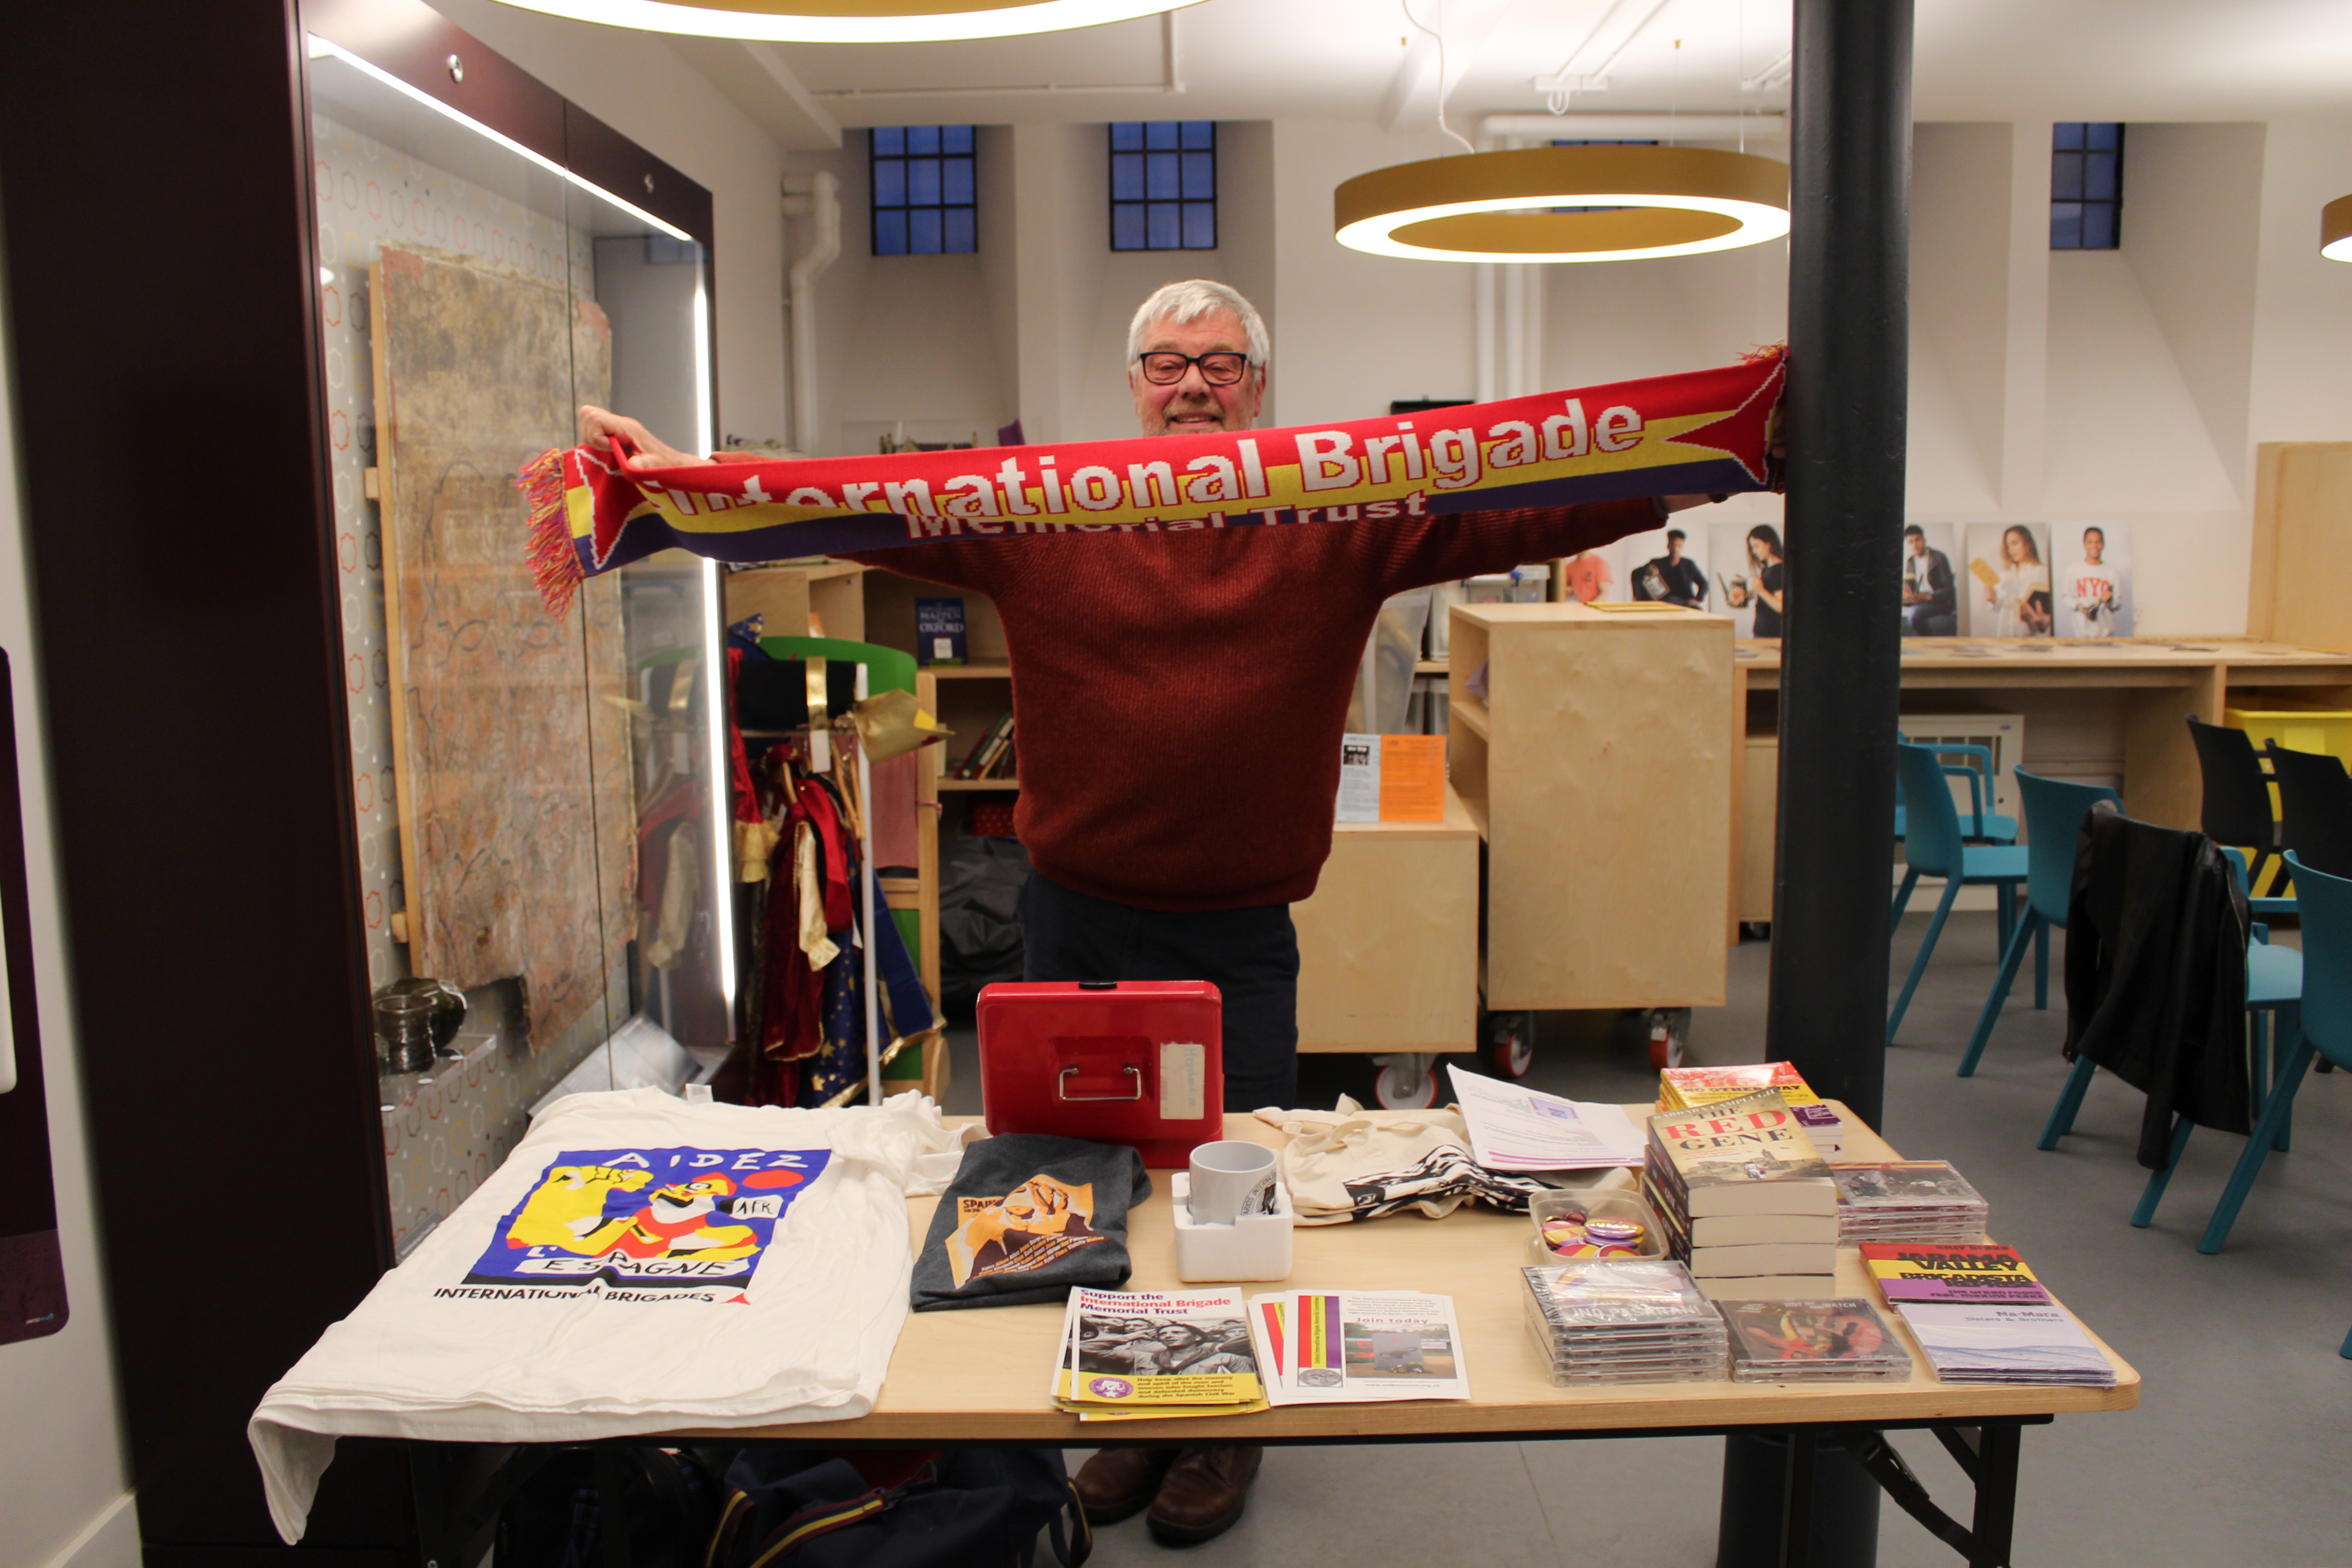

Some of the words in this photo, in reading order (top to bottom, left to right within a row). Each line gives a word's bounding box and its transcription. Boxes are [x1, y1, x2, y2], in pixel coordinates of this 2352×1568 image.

[1294, 398, 1643, 492] Brigade
[1250, 491, 1429, 525] Trust
[1693, 1107, 1742, 1119] THE
[1664, 1111, 1787, 1140] RED
[1680, 1128, 1793, 1150] GENE
[546, 1251, 727, 1275] ESPAGNE
[1913, 1261, 2019, 1271] VALLEY
[433, 1285, 600, 1299] INTERNATIONAL
[604, 1292, 715, 1303] BRIGADES
[1080, 1289, 1135, 1301] Support
[1080, 1296, 1171, 1307] International
[1176, 1298, 1231, 1308] Brigade
[1080, 1303, 1148, 1314] Memorial
